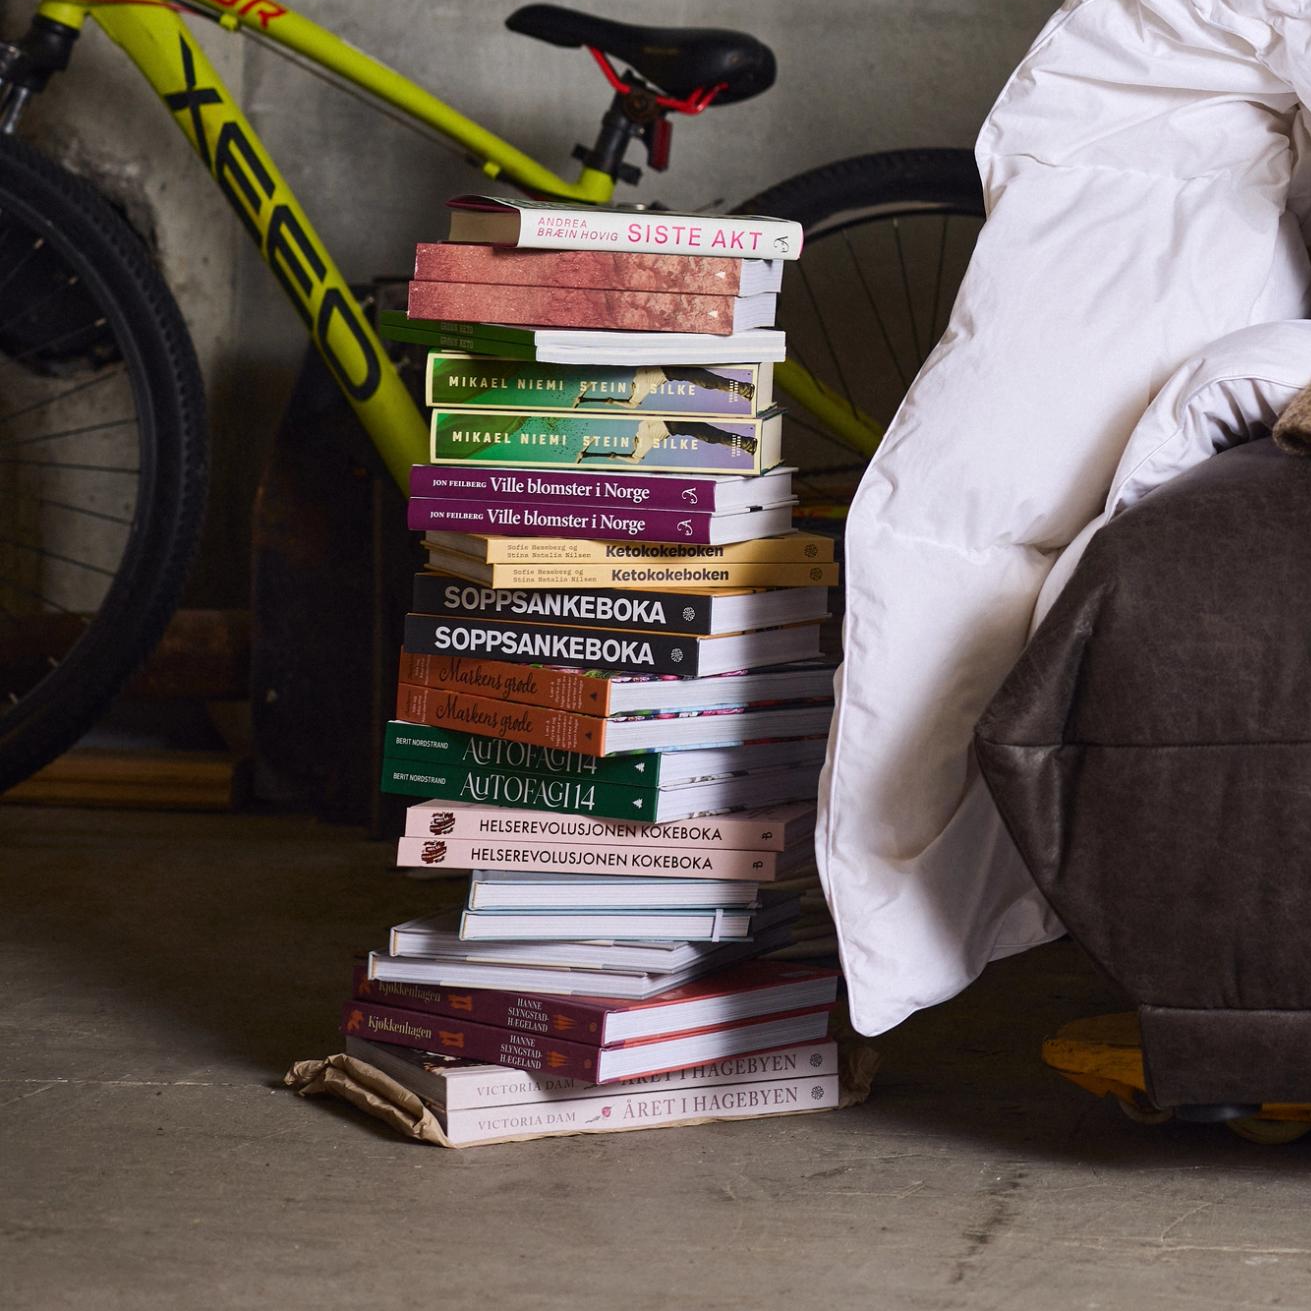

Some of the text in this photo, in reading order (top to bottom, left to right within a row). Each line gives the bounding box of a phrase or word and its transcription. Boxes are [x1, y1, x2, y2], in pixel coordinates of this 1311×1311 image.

[538, 217, 587, 229] ANDREA
[580, 230, 618, 242] HOVIG
[627, 224, 763, 250] SISTE AKT
[449, 375, 508, 389] MIKAEL
[517, 378, 564, 391] NIEMI
[579, 380, 627, 394] STEIN
[649, 383, 696, 396] SILKE
[452, 431, 511, 444] MIKAEL
[520, 433, 567, 446] NIEMI
[582, 436, 629, 448] STEIN
[652, 437, 699, 450] SILKE
[432, 479, 448, 487] JON
[449, 480, 487, 488] FEILBERG
[489, 477, 525, 493] Ville
[527, 478, 593, 497] blomster
[604, 483, 650, 503] Norge
[430, 511, 445, 519] JON
[446, 512, 484, 520] FEILBERG
[486, 508, 521, 524] Ville
[523, 510, 590, 529] blomster
[600, 514, 646, 535] Norge
[605, 545, 724, 558] Ketokokeboken
[611, 568, 729, 582] Ketokokeboken
[443, 586, 667, 624] SOPPSANKEBOKA
[434, 626, 655, 665] SOPPSANKEBOKA
[439, 657, 502, 690] Markens
[435, 694, 498, 728] Markens
[395, 737, 449, 750] BERIT NORDSTRAND
[393, 772, 446, 785] BERIT NORDSTRAND
[575, 784, 596, 811] 14
[479, 819, 723, 841] HELSEREVOLUSJONEN KOKEBOKA
[470, 848, 713, 870] HELSEREVOLUSJONEN KOKEBOKA
[517, 998, 543, 1010] HANNE
[510, 1034, 536, 1047] HANNE
[477, 1081, 541, 1096] VICTORIA
[546, 1079, 574, 1090] DAM
[692, 1054, 797, 1079] HAGEBYEN
[478, 1115, 542, 1130] VICTORIA
[547, 1112, 576, 1124] DAM
[623, 1098, 676, 1119] ÅRET
[694, 1087, 799, 1112] HAGEBYEN
